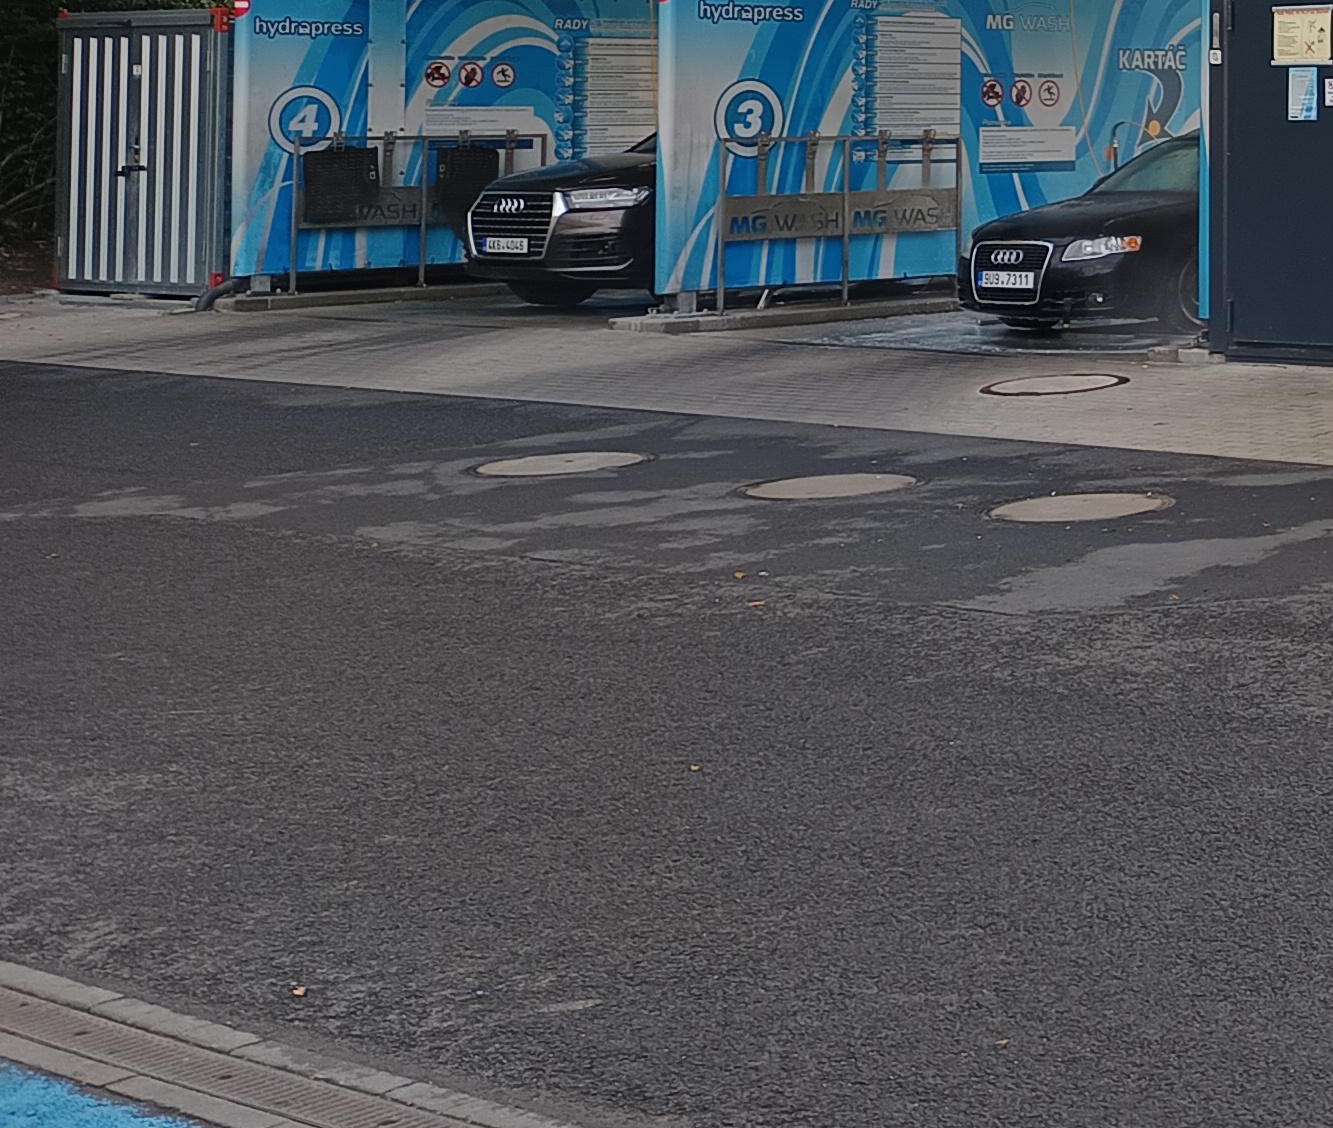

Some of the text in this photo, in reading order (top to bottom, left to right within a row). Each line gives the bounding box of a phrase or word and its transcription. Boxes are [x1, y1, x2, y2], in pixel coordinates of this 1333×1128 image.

[851, 0, 878, 9] RADY
[554, 17, 589, 31] RADY
[985, 14, 1014, 30] MG
[1118, 45, 1187, 70] KARTÁČ
[287, 103, 319, 139] 4
[733, 99, 764, 139] 3
[730, 215, 769, 234] MG
[852, 210, 888, 228] MG
